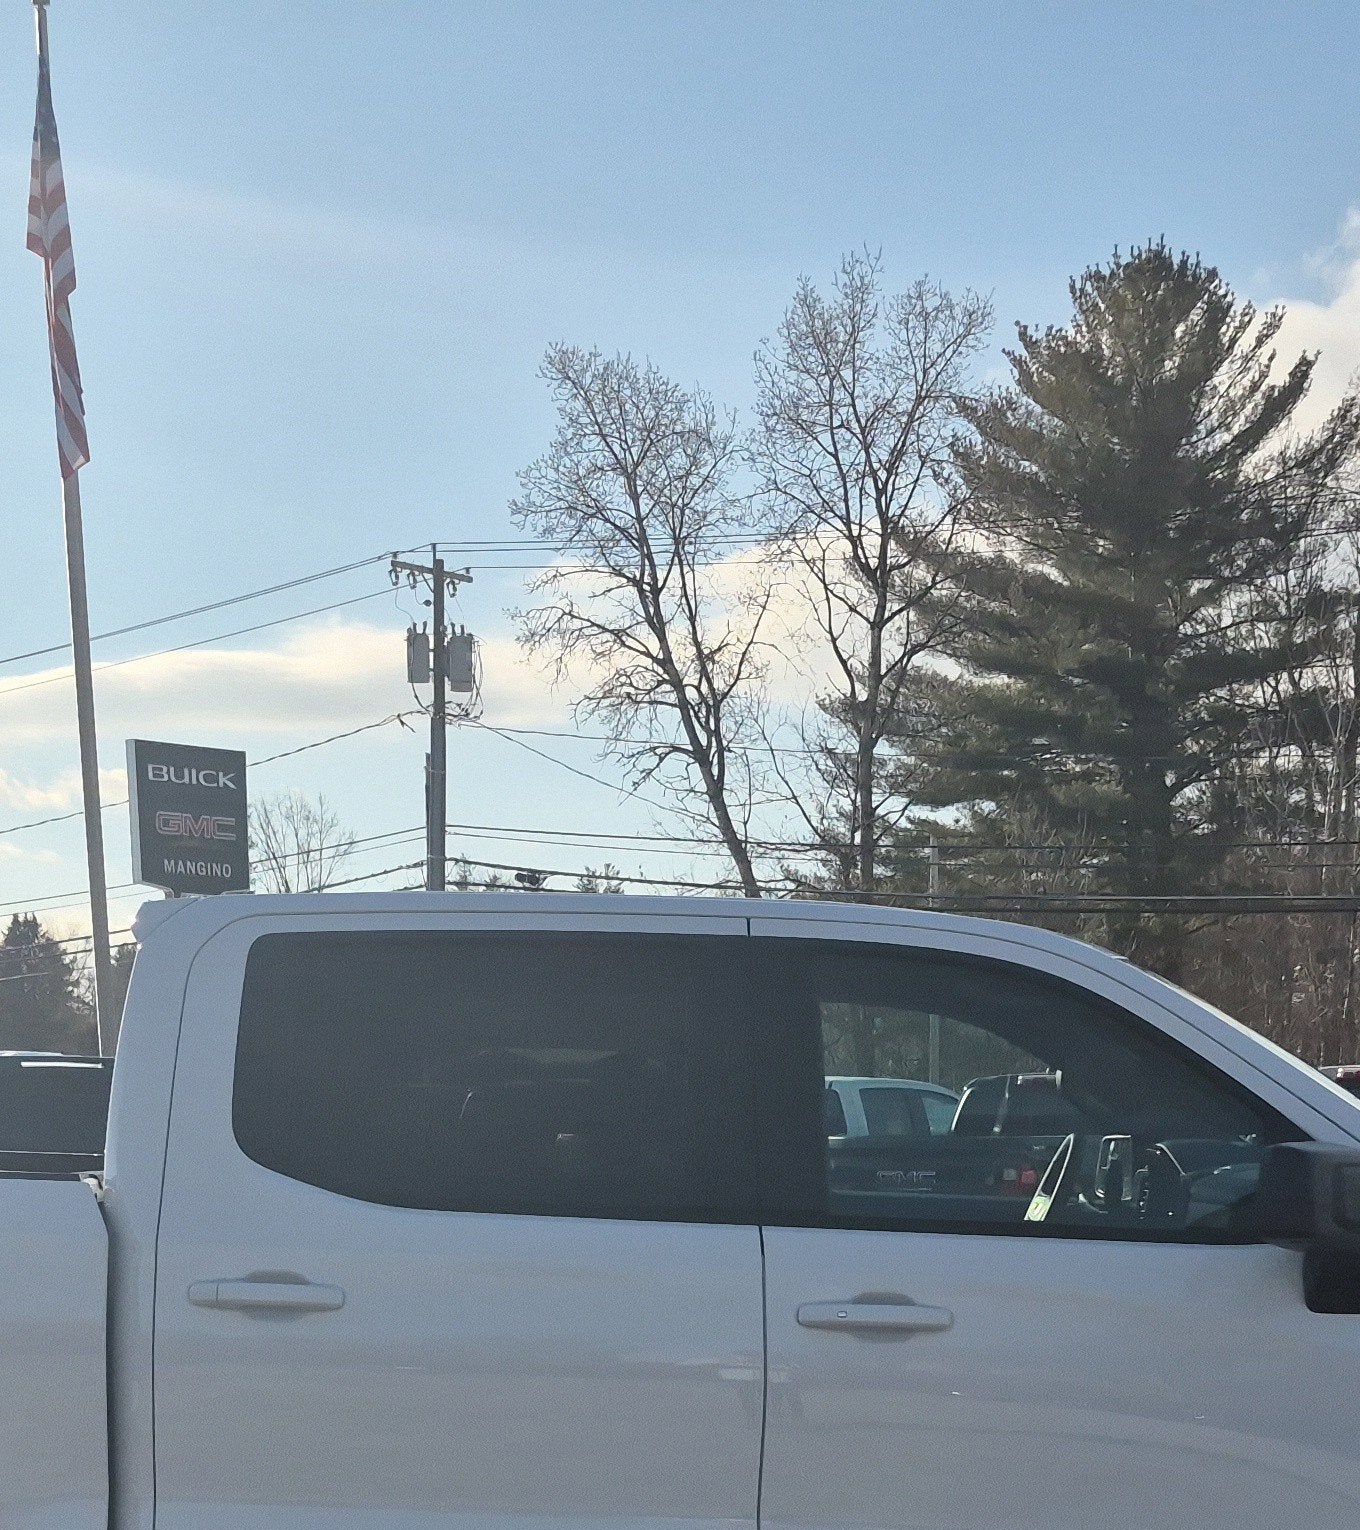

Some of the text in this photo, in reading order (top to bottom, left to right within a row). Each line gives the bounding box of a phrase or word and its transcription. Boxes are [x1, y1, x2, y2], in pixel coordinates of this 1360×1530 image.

[148, 764, 237, 789] BUICK
[157, 812, 236, 840] GMC
[164, 859, 232, 878] MANGINO
